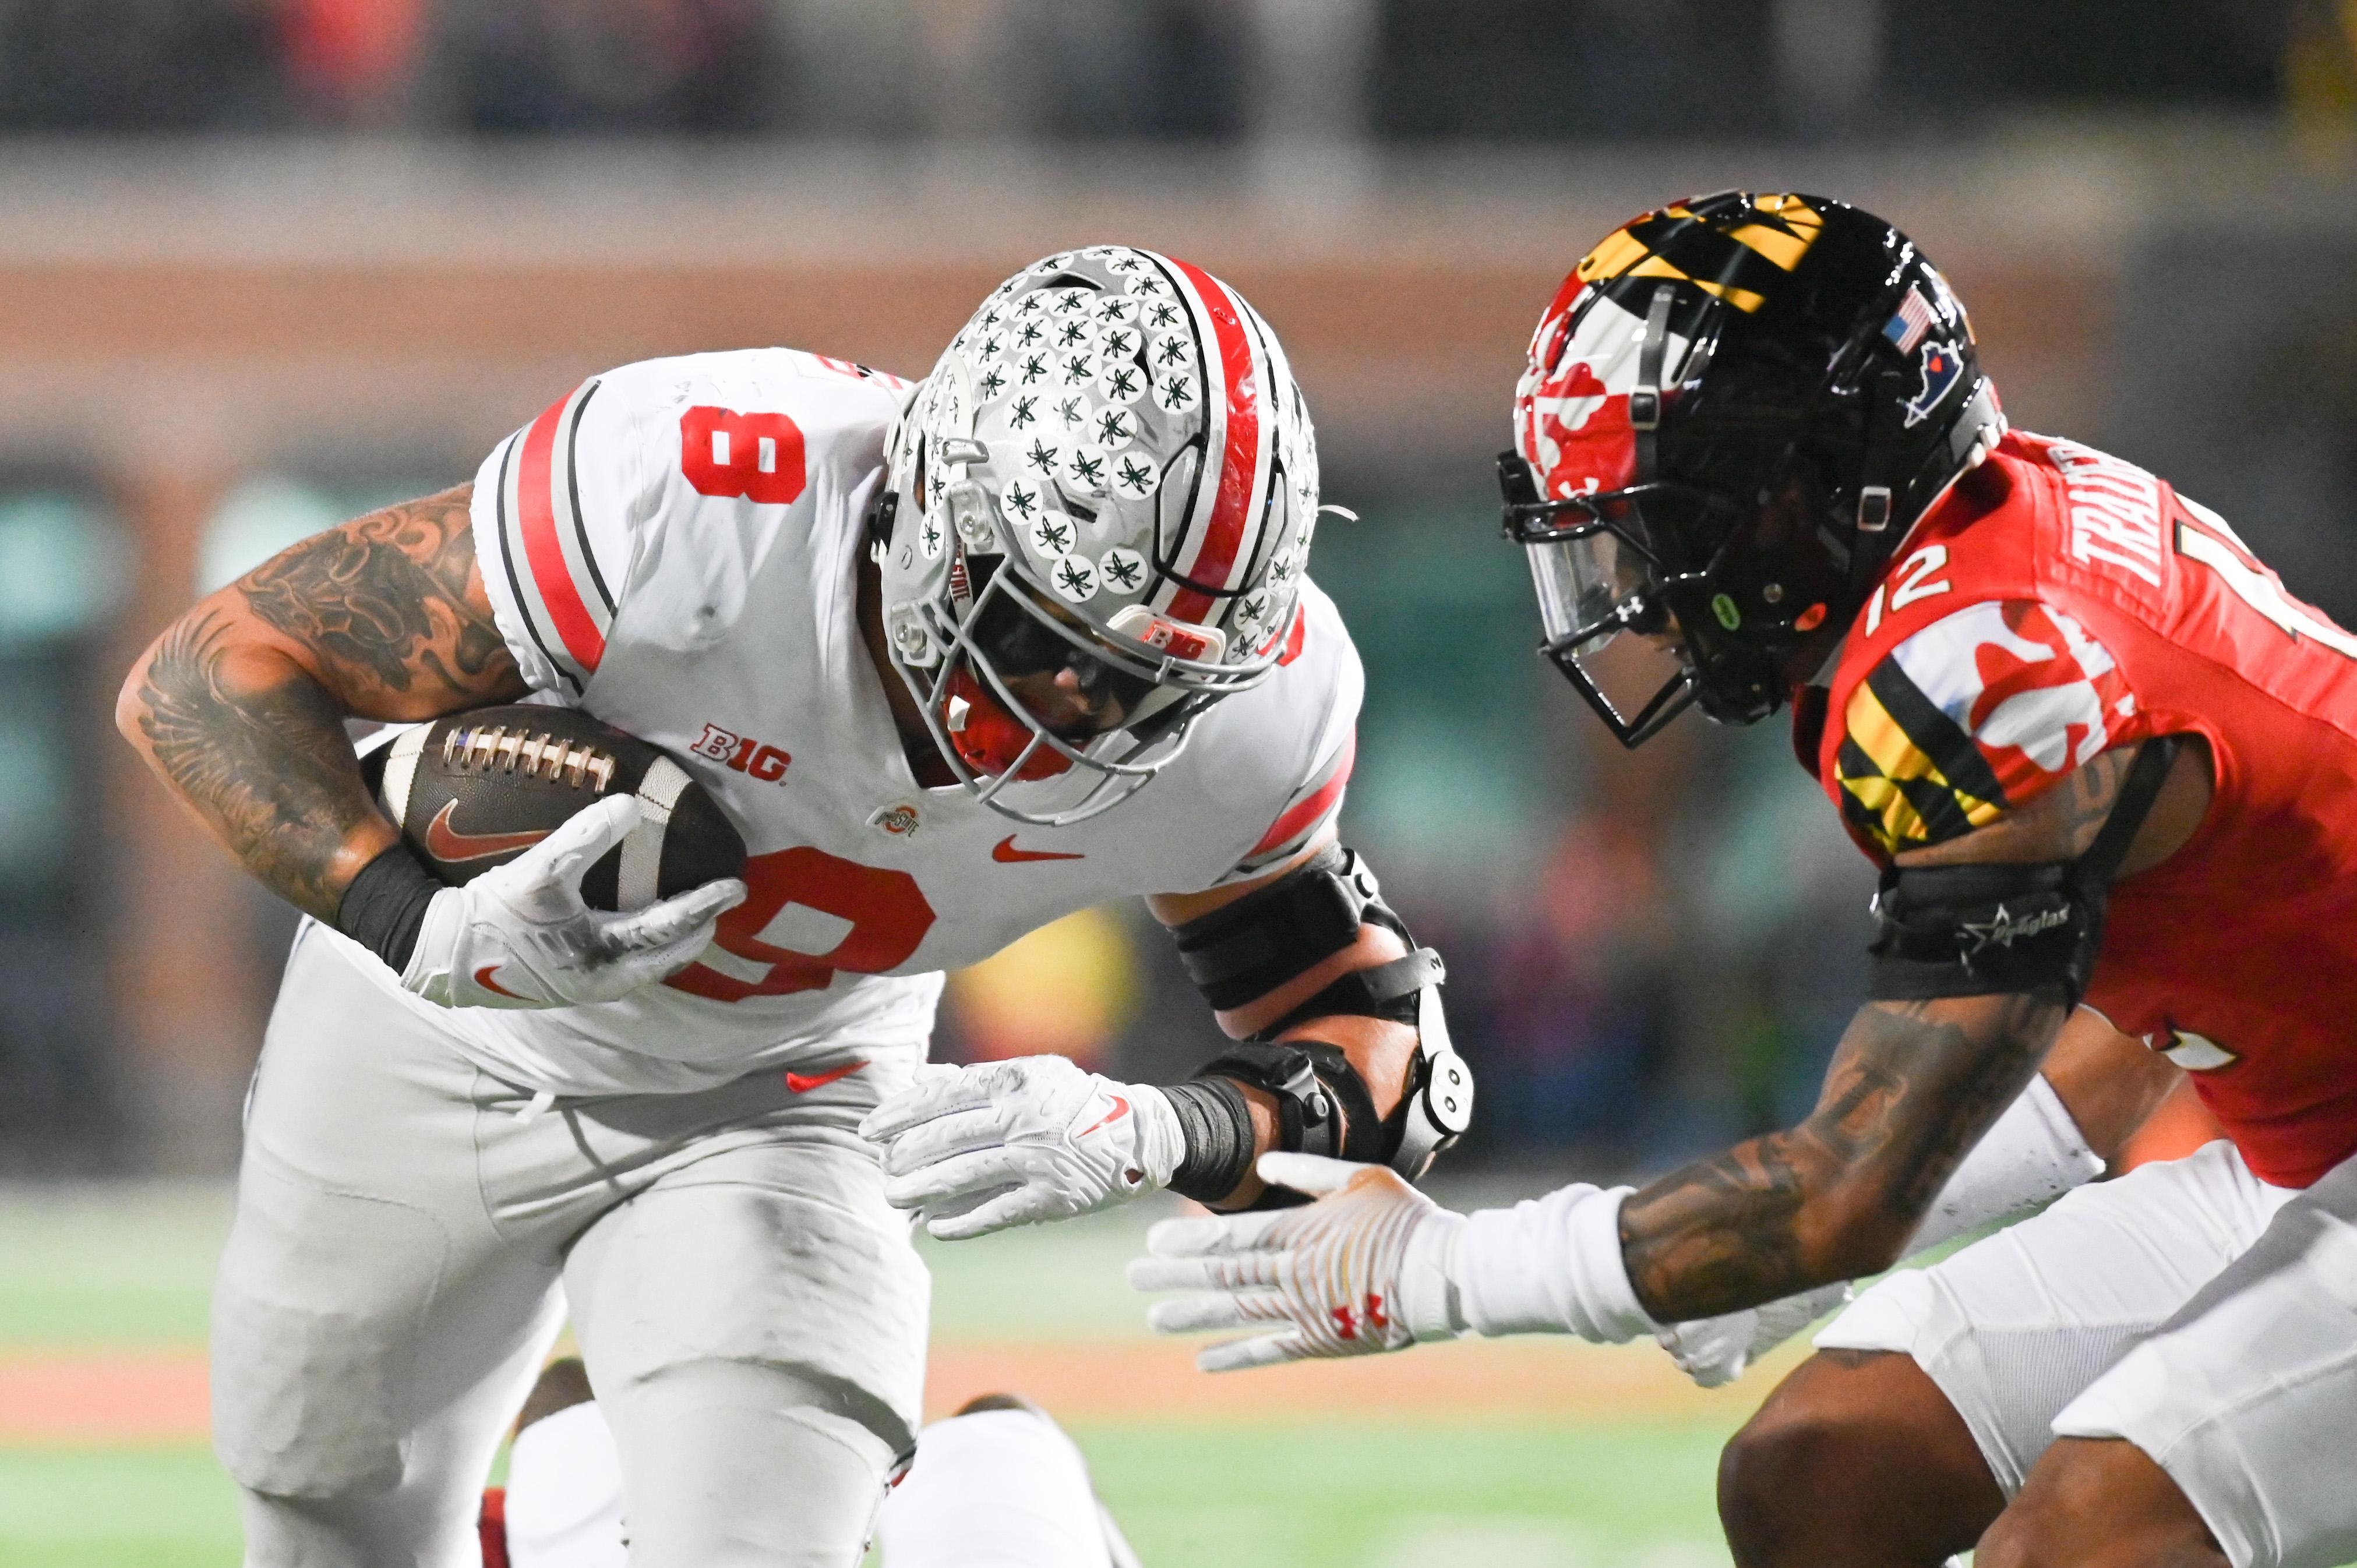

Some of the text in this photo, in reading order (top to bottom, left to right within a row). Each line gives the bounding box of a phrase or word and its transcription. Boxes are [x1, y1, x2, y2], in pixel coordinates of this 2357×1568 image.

[680, 405, 806, 504] 8
[2047, 443, 2161, 587] TRAD
[1865, 544, 1952, 637] 12
[661, 846, 937, 1002] 8
